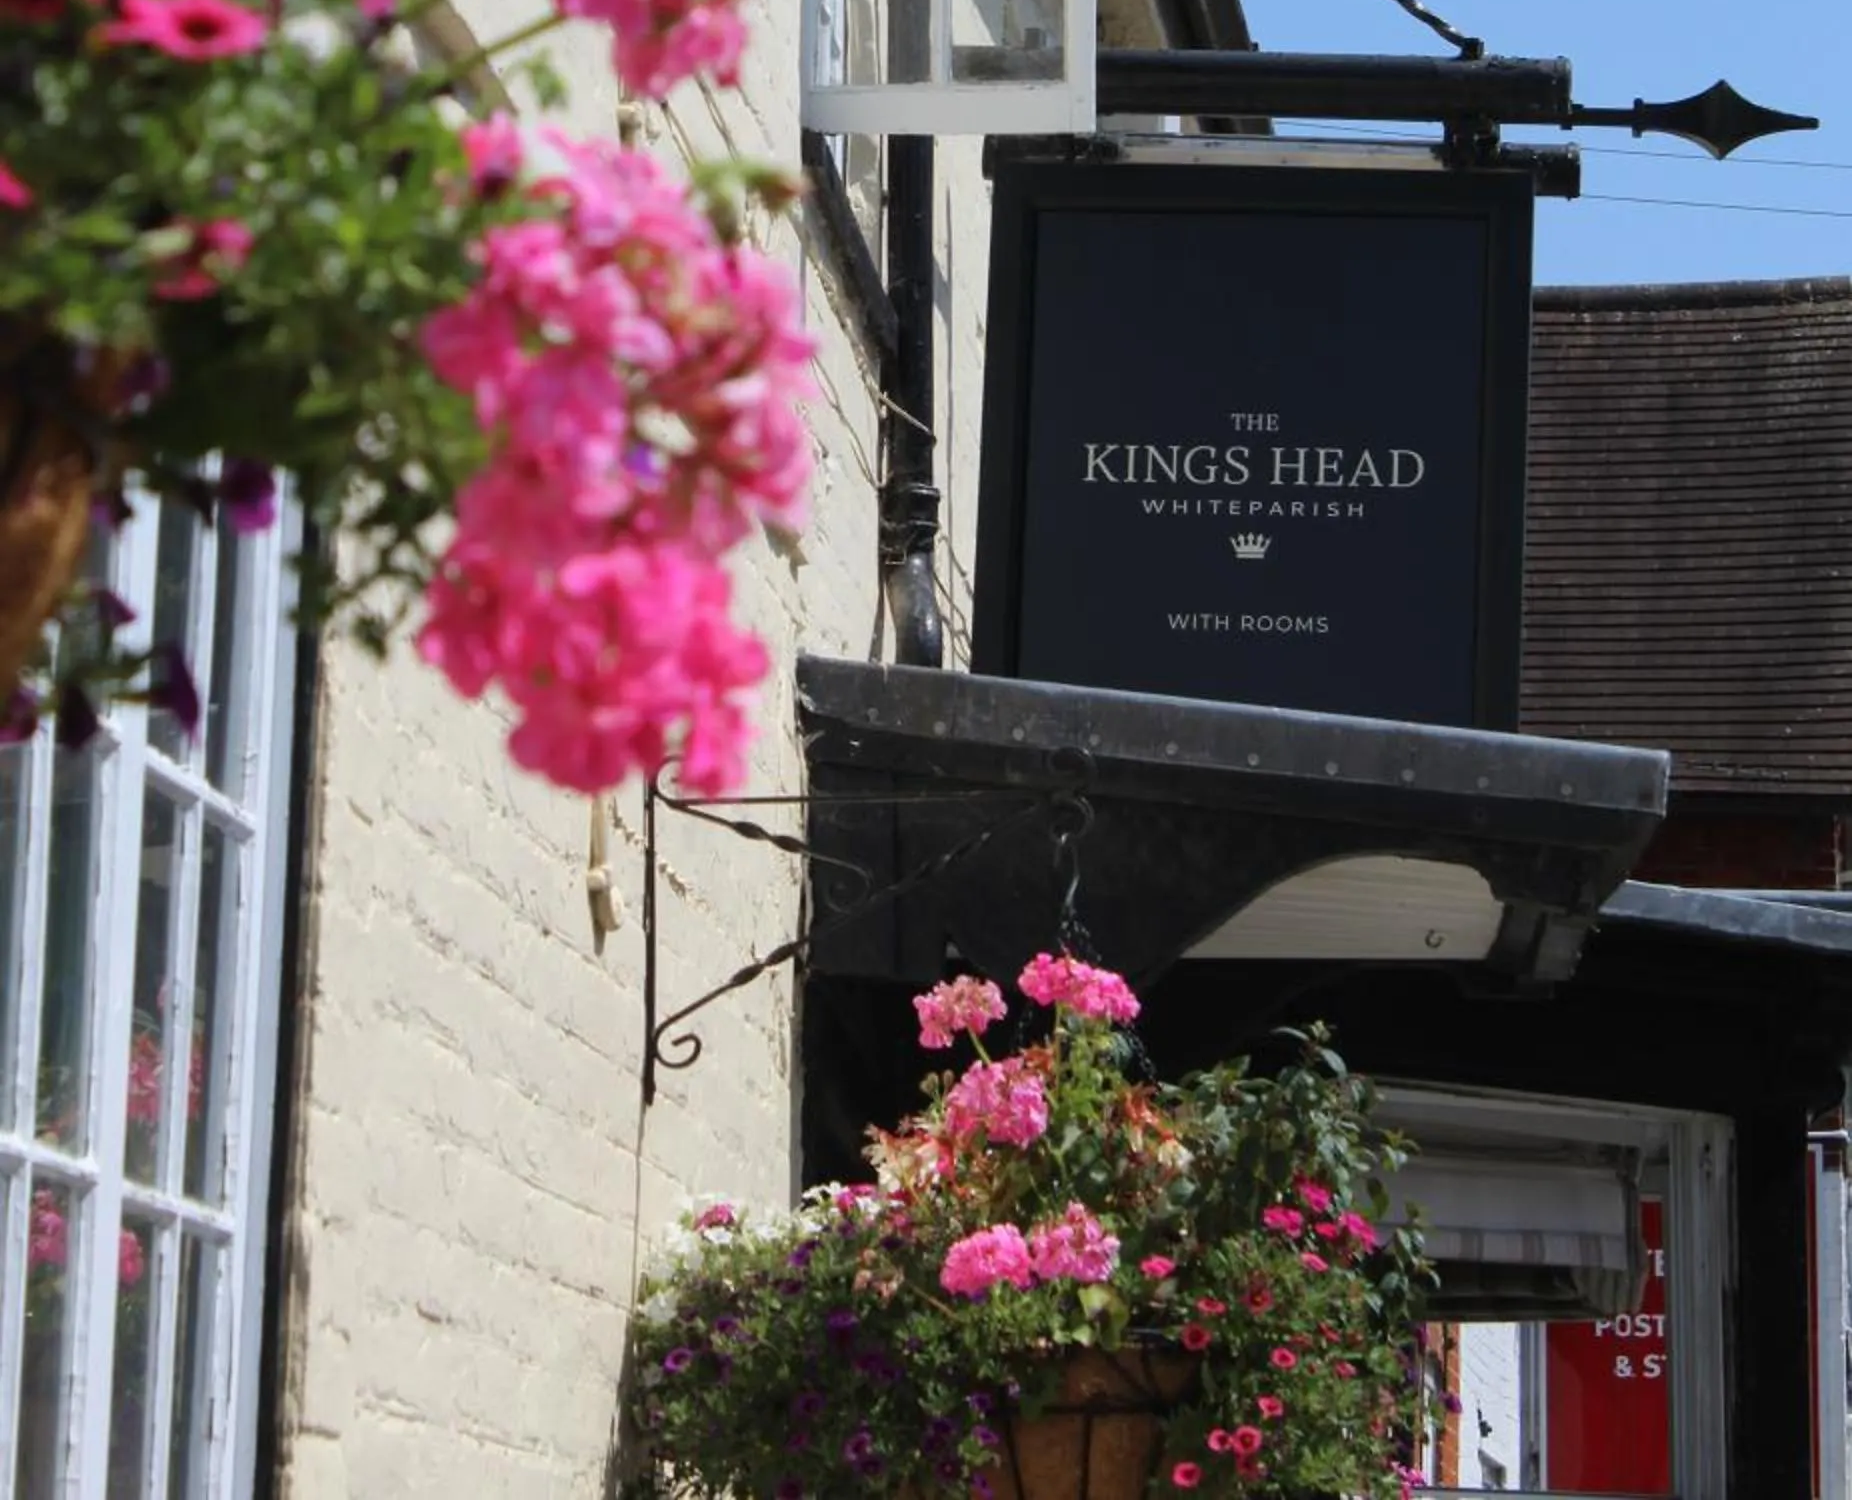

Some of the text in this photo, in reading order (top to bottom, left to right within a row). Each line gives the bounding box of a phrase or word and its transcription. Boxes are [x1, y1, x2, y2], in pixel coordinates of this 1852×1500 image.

[1230, 412, 1279, 432] THE
[1082, 443, 1426, 489] KINGS HEAD
[1141, 498, 1365, 518] WHITEPARISH
[1167, 612, 1330, 634] WITH ROOMS
[1613, 1354, 1668, 1379] & S
